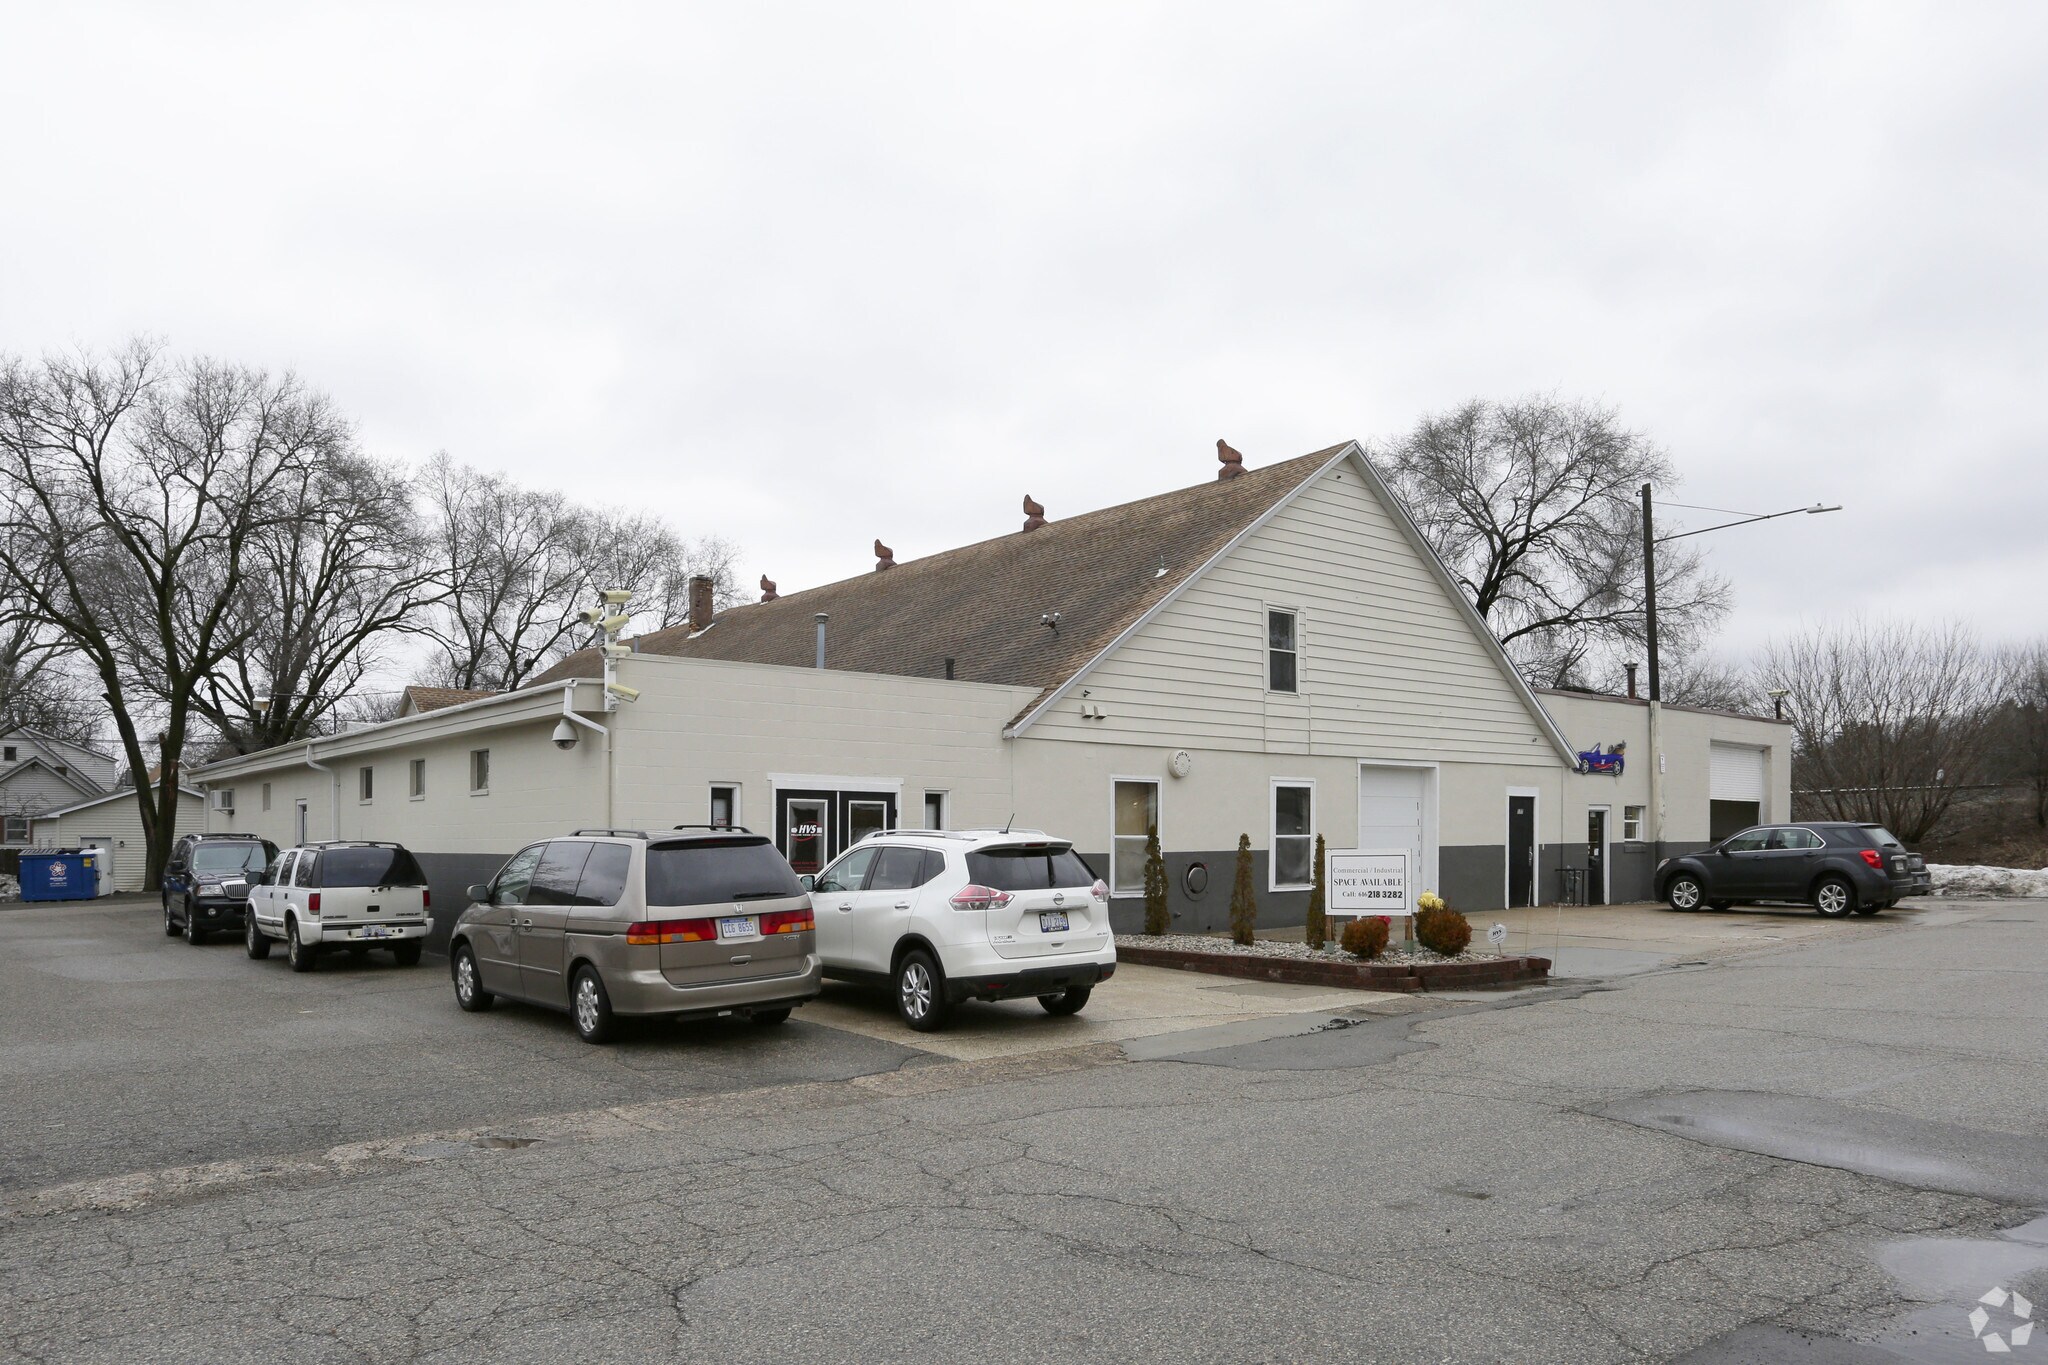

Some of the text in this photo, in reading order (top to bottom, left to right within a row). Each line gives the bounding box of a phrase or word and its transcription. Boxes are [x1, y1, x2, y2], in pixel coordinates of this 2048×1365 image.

[798, 825, 817, 833] HVS
[1333, 878, 1403, 886] SPACE AVAILABLE
[1368, 890, 1381, 898] 218
[1382, 890, 1403, 898] 3282
